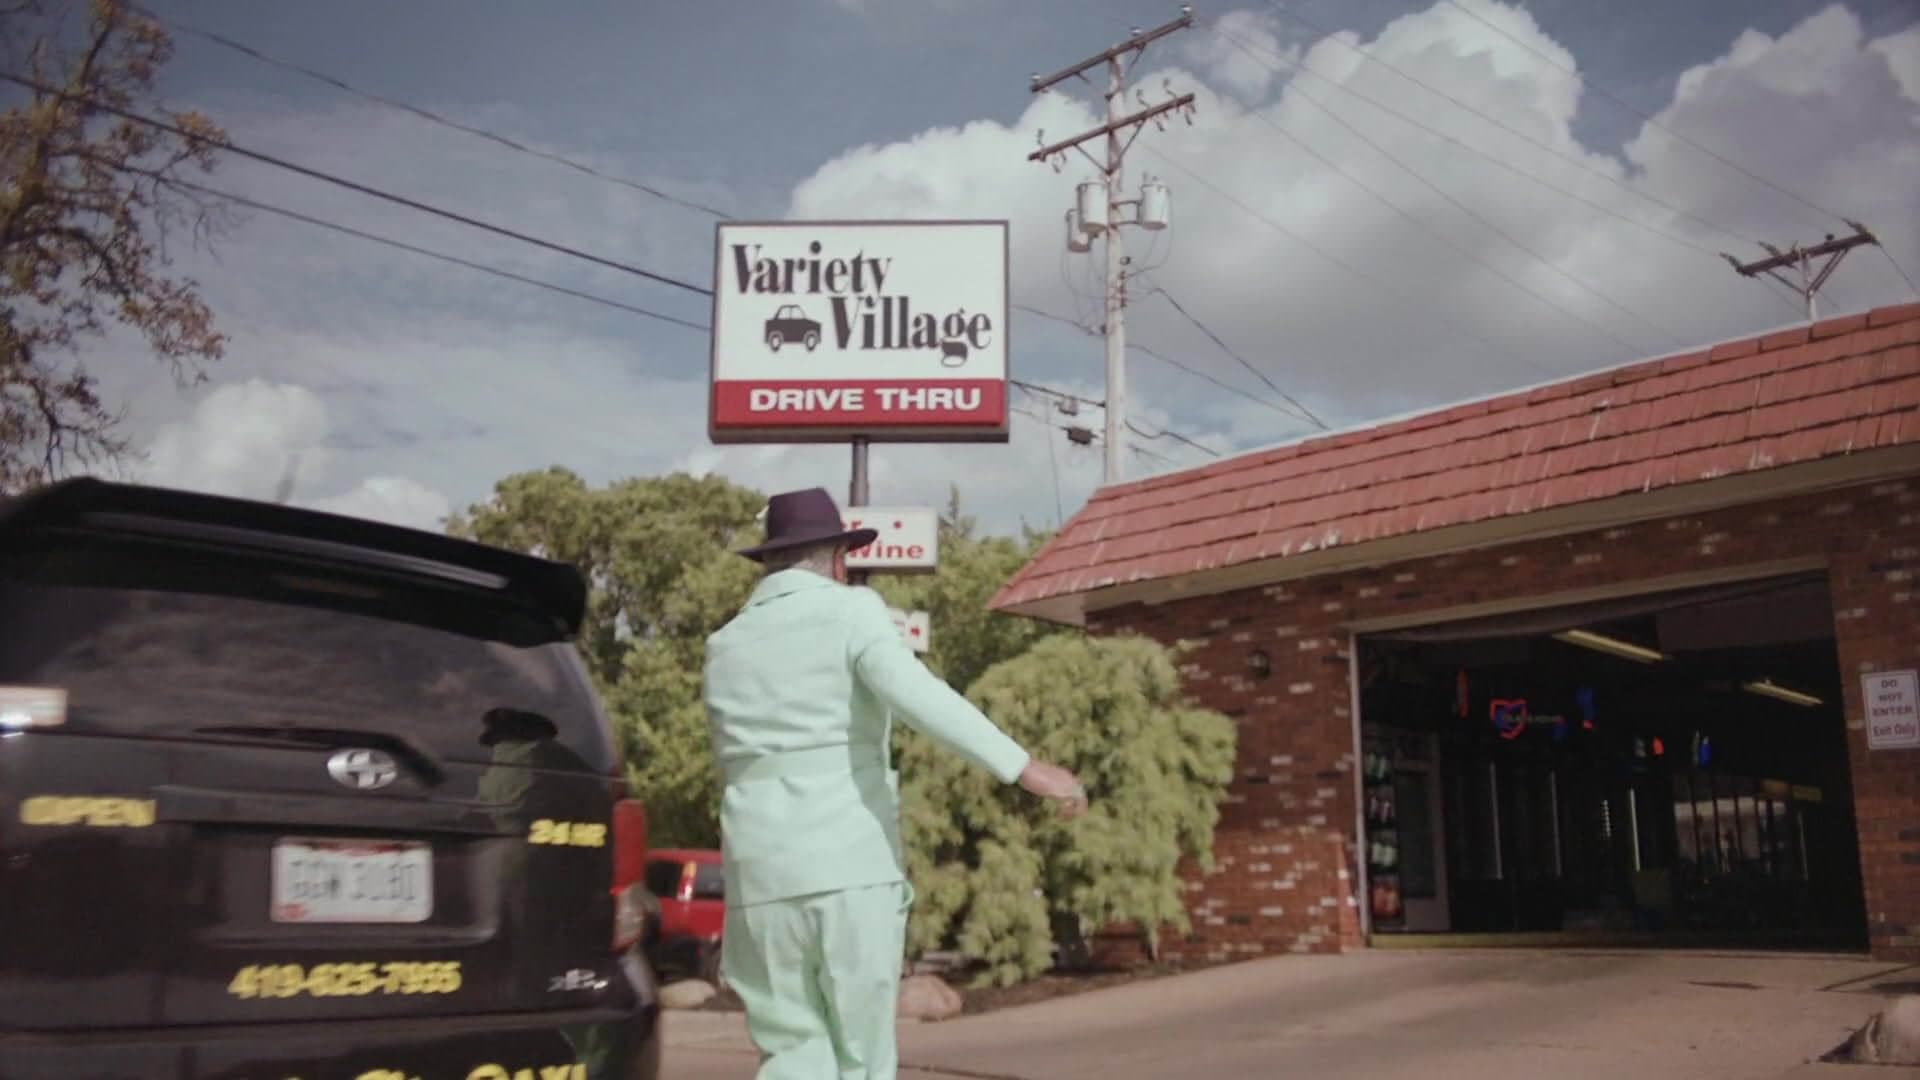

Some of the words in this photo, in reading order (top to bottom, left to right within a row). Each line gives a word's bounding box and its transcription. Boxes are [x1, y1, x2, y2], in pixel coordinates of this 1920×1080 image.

[731, 240, 892, 295] Variety
[828, 295, 992, 368] Village
[750, 388, 864, 411] DRIVE
[875, 387, 981, 410] THRU
[1881, 679, 1897, 688] DO
[1878, 692, 1902, 702] NOT
[1872, 705, 1912, 716] ENTER
[527, 818, 570, 845] 24
